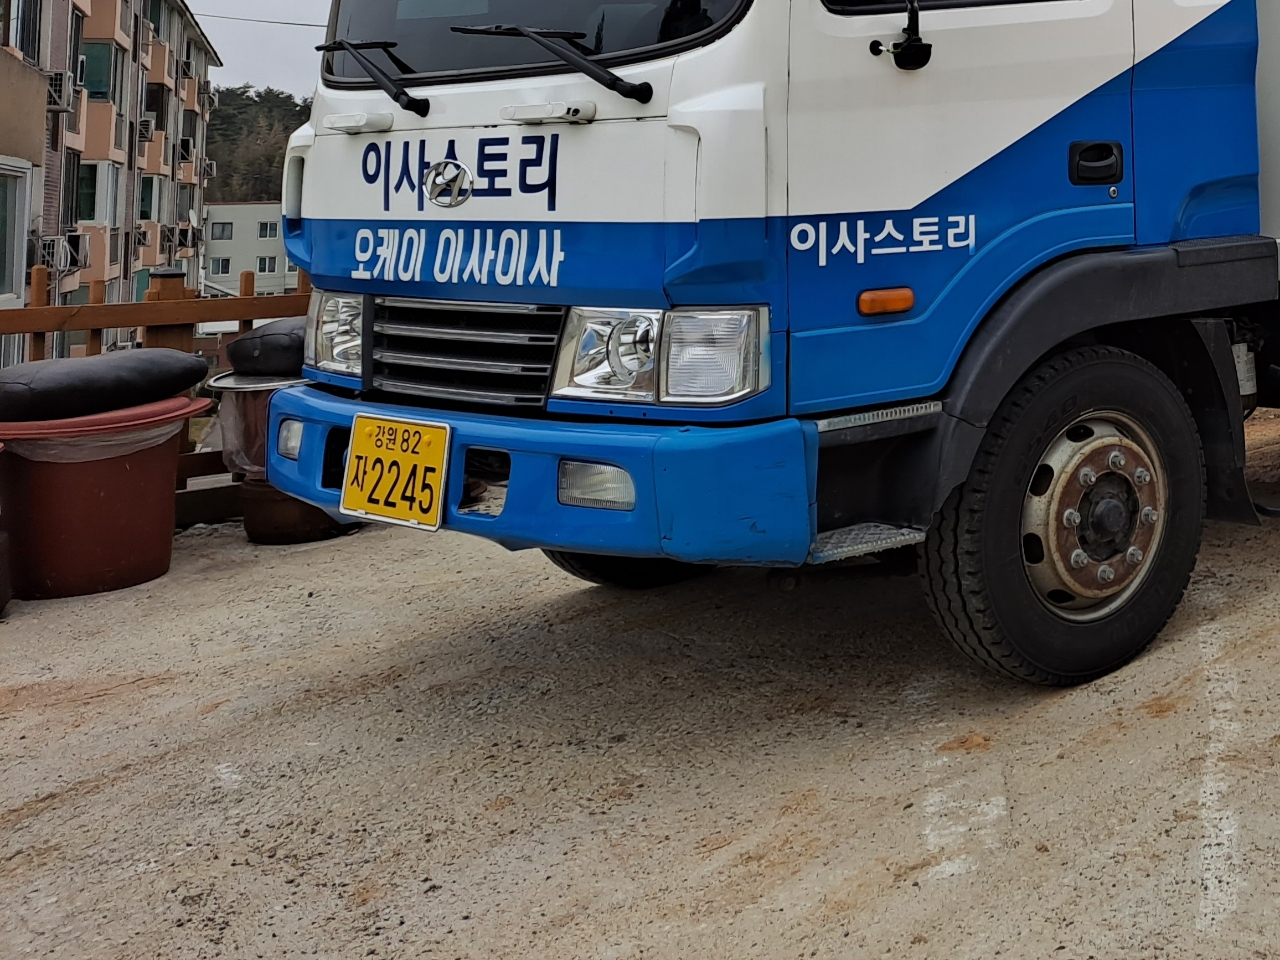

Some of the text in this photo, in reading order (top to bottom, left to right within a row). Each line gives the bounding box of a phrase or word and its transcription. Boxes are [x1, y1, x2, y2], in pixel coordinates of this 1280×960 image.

[351, 228, 565, 287] 오케이 이사이사
[790, 214, 976, 267] 이사스토리
[350, 454, 437, 515] 자2245
